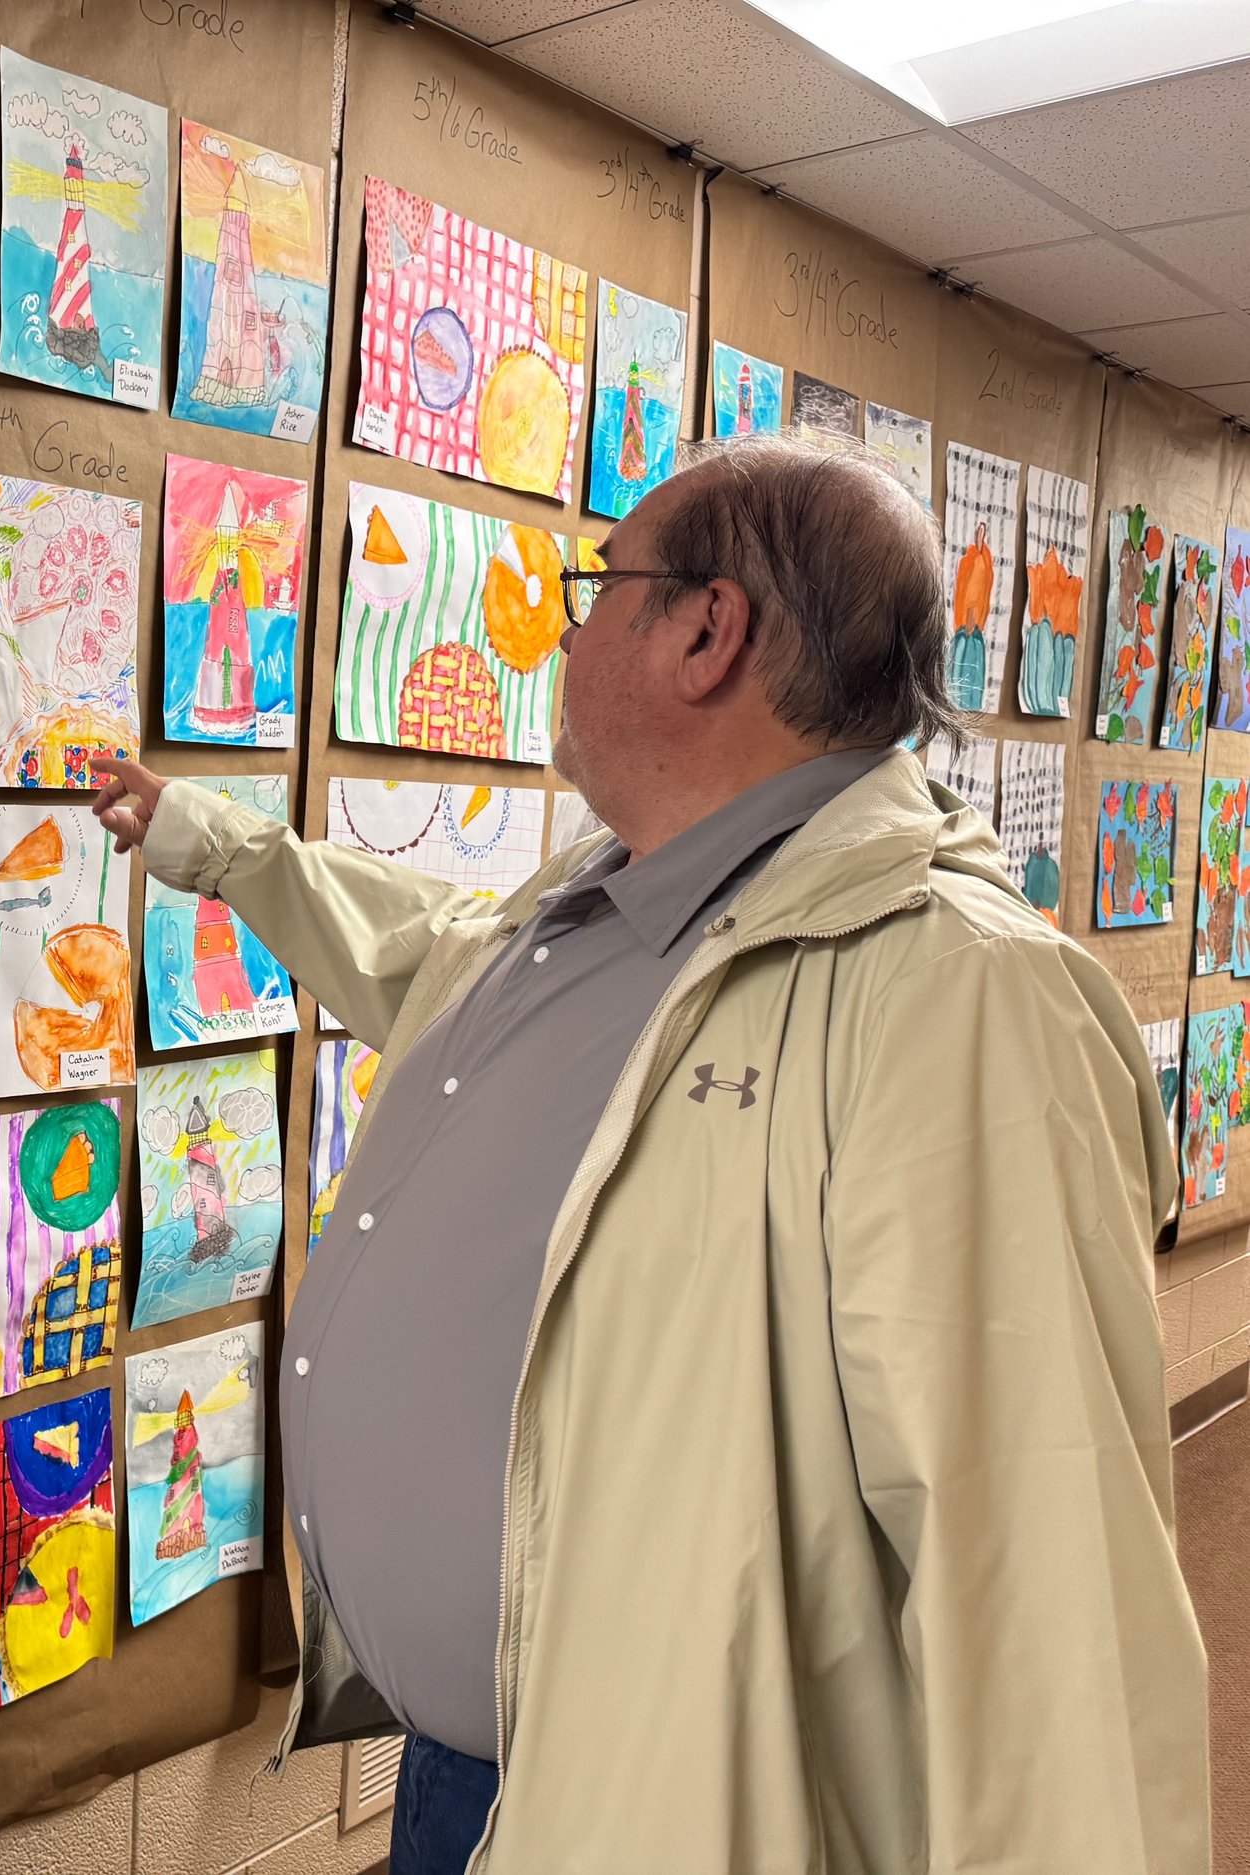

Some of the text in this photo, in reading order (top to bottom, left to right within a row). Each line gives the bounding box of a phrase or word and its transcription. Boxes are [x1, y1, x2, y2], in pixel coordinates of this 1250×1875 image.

[464, 106, 523, 165] Grade
[648, 181, 686, 223] Grade
[835, 279, 898, 350] Grade
[119, 363, 154, 382] Elizabeth
[978, 348, 1063, 417] 2nd Grade
[284, 406, 305, 420] Asher
[279, 418, 297, 432] Rice
[33, 420, 129, 484] Grade
[259, 714, 281, 727] Grady
[258, 1002, 287, 1014] George
[67, 1053, 105, 1065] Catalina
[67, 1069, 99, 1081] Wagner
